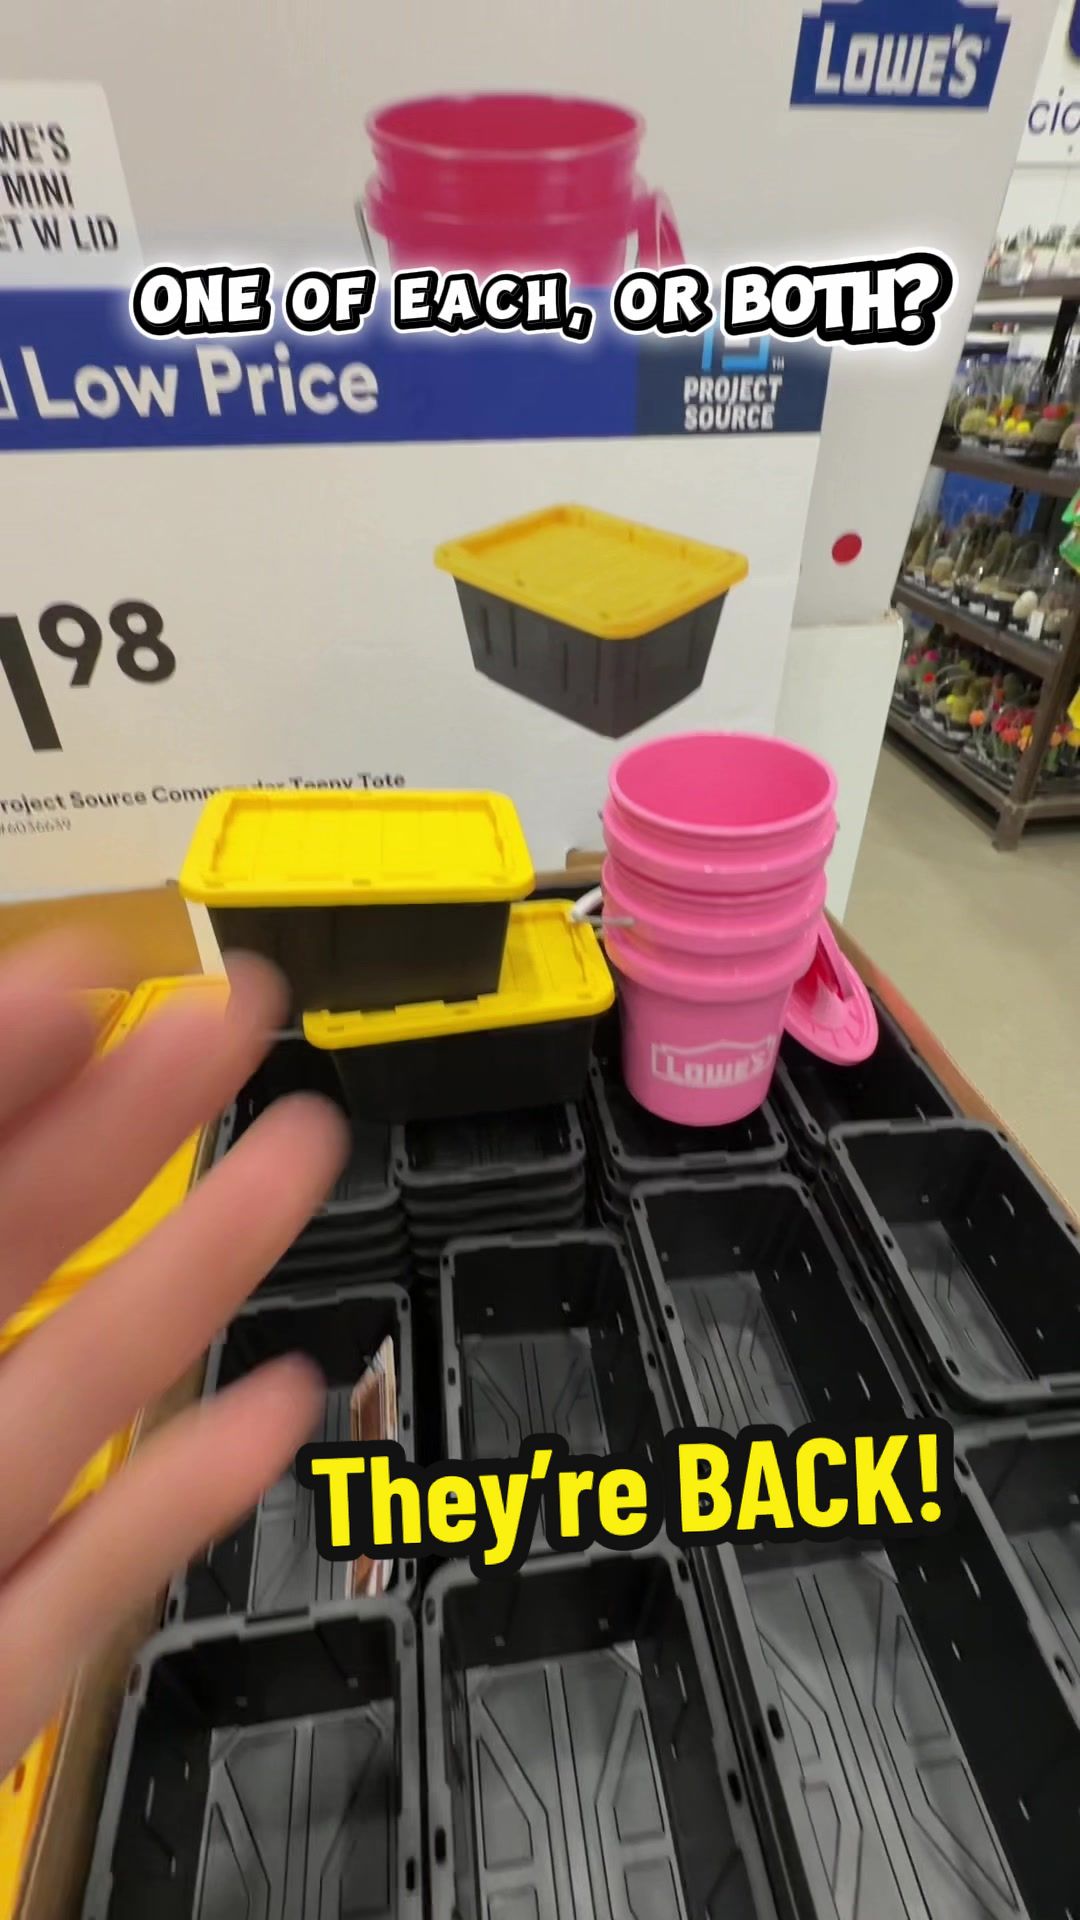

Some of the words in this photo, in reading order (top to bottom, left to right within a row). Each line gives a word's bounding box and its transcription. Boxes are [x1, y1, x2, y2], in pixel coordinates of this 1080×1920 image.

[814, 20, 986, 99] LOWE'S
[0, 171, 75, 207] MINI
[30, 214, 62, 252] W
[68, 214, 119, 252] LID
[20, 345, 179, 420] Low
[195, 340, 380, 418] Price
[683, 374, 783, 406] PROJECT
[684, 402, 775, 432] SOURCE
[69, 789, 148, 810] Source
[356, 771, 406, 790] Tote
